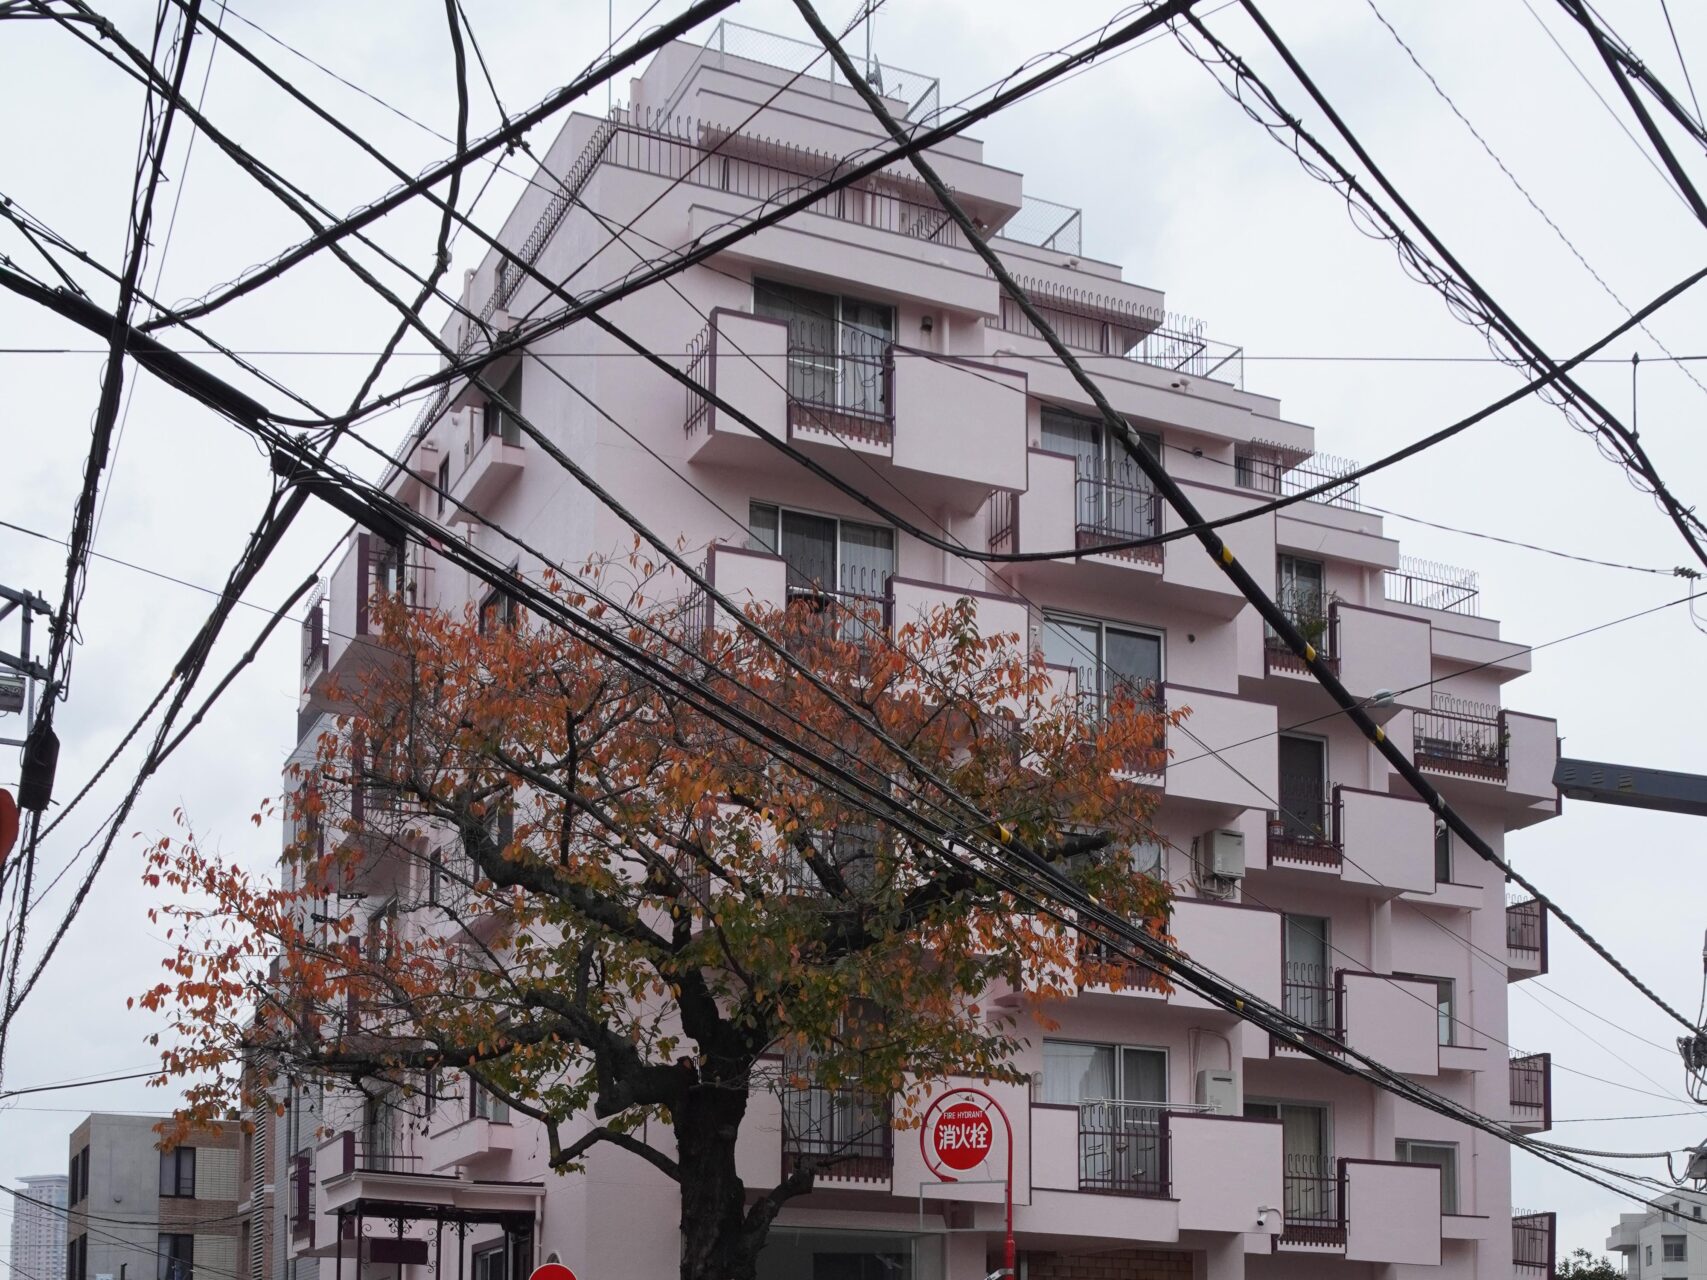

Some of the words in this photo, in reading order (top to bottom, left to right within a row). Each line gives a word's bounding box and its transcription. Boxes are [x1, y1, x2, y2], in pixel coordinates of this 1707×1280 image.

[943, 1111, 956, 1119] FIRE
[957, 1110, 983, 1119] HYDRANT
[938, 1122, 989, 1150] 消火栓
